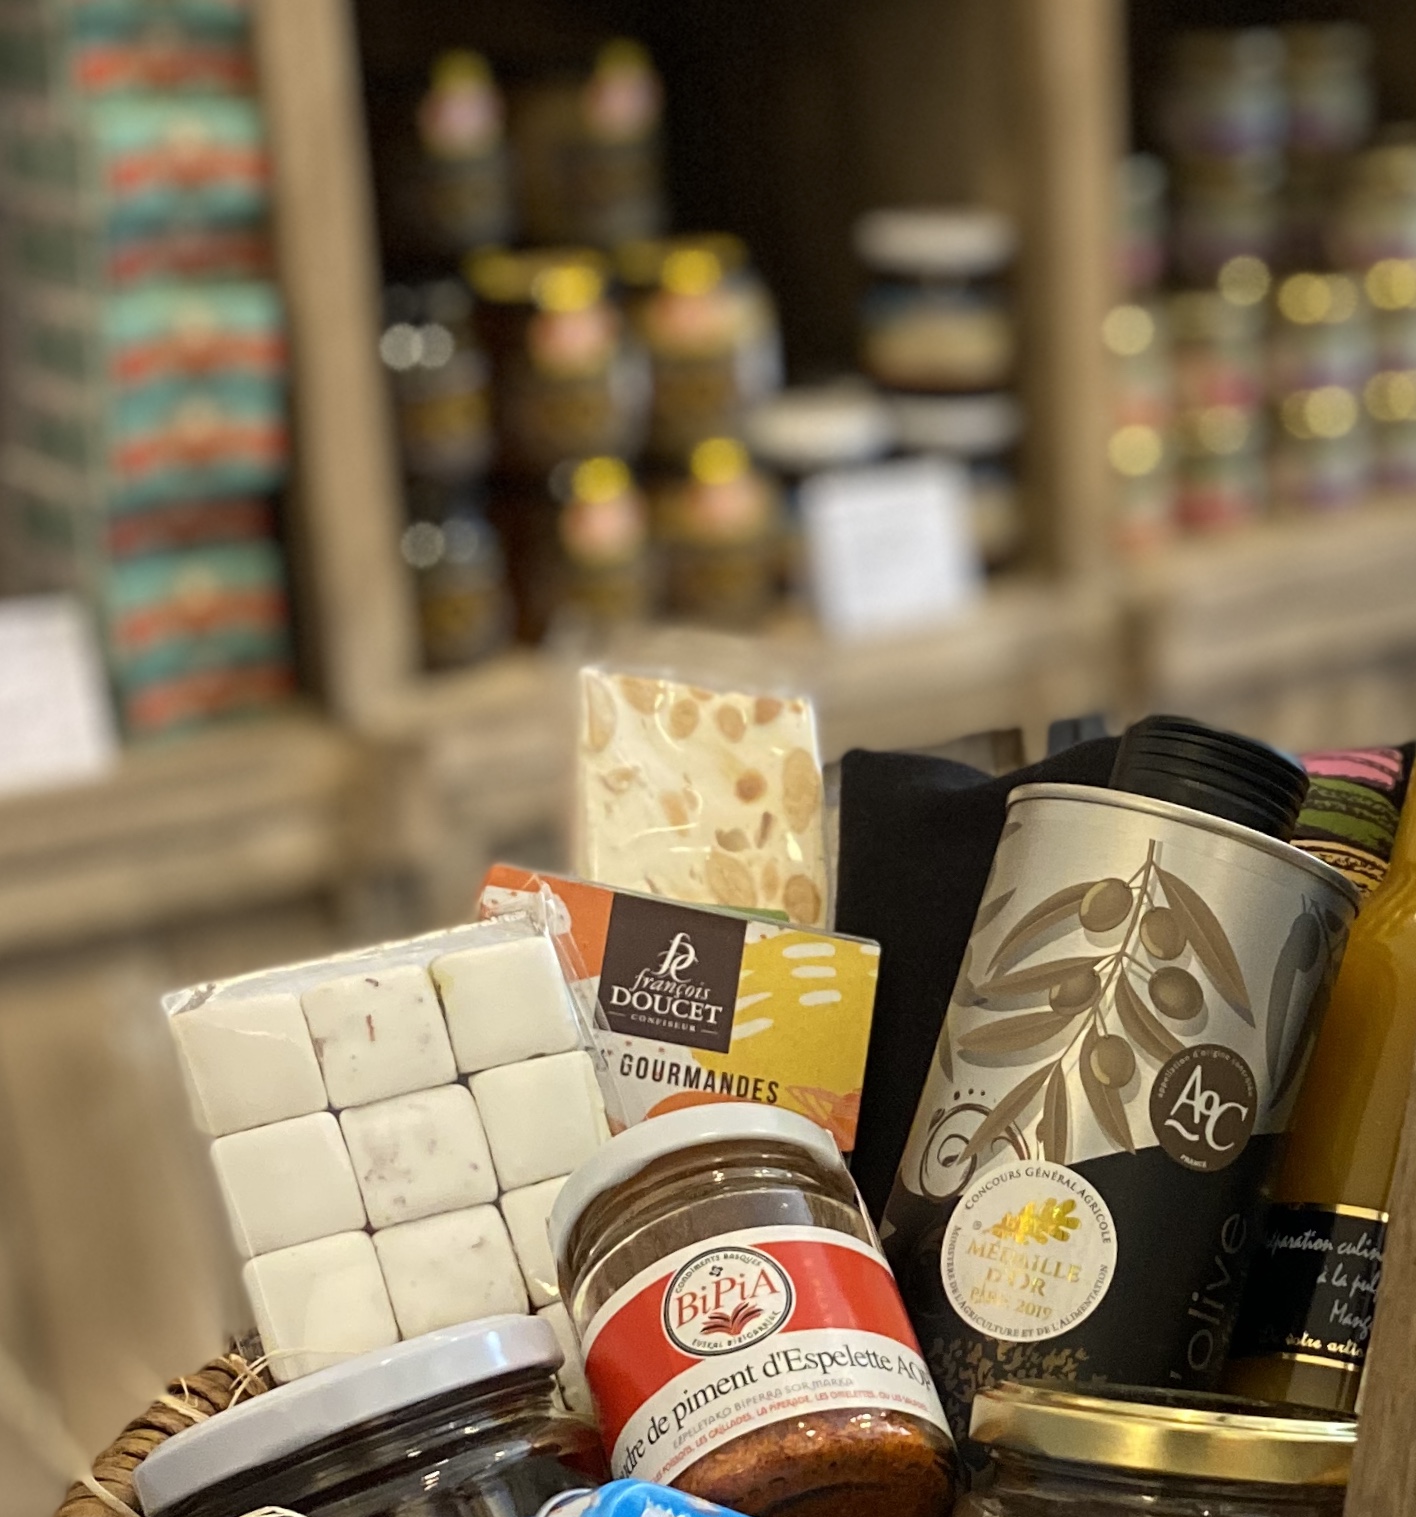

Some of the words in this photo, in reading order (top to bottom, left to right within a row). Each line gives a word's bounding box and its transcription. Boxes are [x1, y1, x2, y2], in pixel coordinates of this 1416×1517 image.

[629, 967, 712, 1001] françois
[609, 985, 724, 1025] DOUCET
[630, 1013, 697, 1033] CONFISEUR
[619, 1052, 781, 1104] GOURMANDES
[964, 1168, 1022, 1211] CONCOURS
[1024, 1166, 1081, 1195] GÉNÉRAL
[1077, 1188, 1113, 1245] AGRICOLE
[675, 1254, 720, 1295] CONDIMENTS
[723, 1252, 762, 1268] BASQUES
[966, 1238, 1083, 1284] MÉDAILLE
[1331, 1261, 1349, 1288] la
[1015, 1299, 1054, 1321] 2019
[691, 1338, 723, 1351] EUSKAL
[1020, 1328, 1034, 1339] ET
[646, 1414, 671, 1446] de
[671, 1363, 759, 1431] piment
[761, 1343, 894, 1379] d'Espelette
[733, 1387, 784, 1413] BIPERRA
